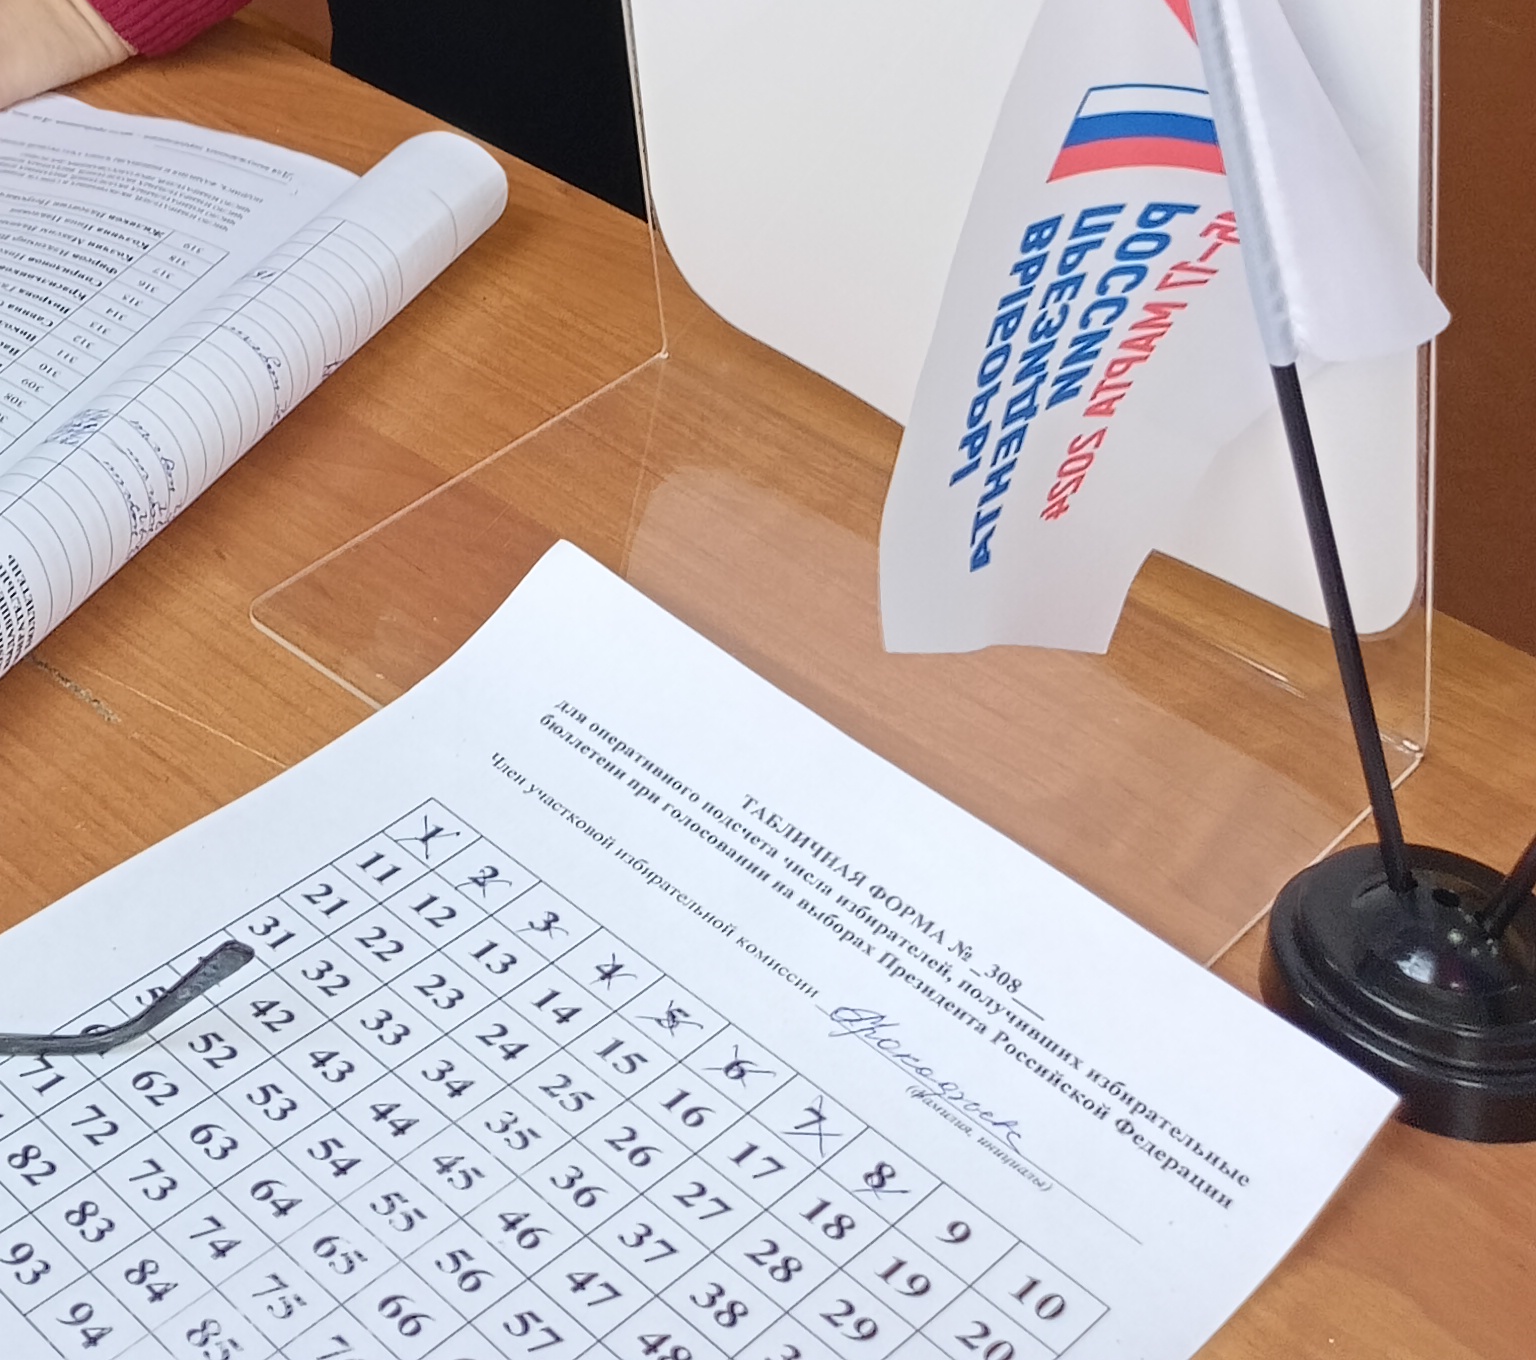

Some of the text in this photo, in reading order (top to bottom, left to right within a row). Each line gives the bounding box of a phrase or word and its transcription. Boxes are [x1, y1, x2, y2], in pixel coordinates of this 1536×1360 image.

[483, 751, 822, 1000] Член участковой избирательной комиссии
[533, 713, 1242, 1210] бюллетени при голосовании на выборах Президента Российской Федерации
[552, 698, 1257, 1189] для оперативного подсчета числа избирателей, получивших избирательные
[732, 793, 873, 888] ТАБЛИЧНАЯ
[860, 881, 955, 946] ФОРМА
[945, 938, 979, 963] №
[248, 916, 748, 1328] 31 32 33 34 35 36 37 38
[302, 884, 878, 1341] 21 22 23 24 25 26 27 28 29
[357, 852, 1015, 1360] 11 12 13 14 15 16 17 18 19 20
[905, 1085, 1054, 1192] (фамилия, инициалы)
[936, 1220, 972, 1246] 9
[1011, 1277, 1066, 1320] 10
[57, 1303, 113, 1349] 94
